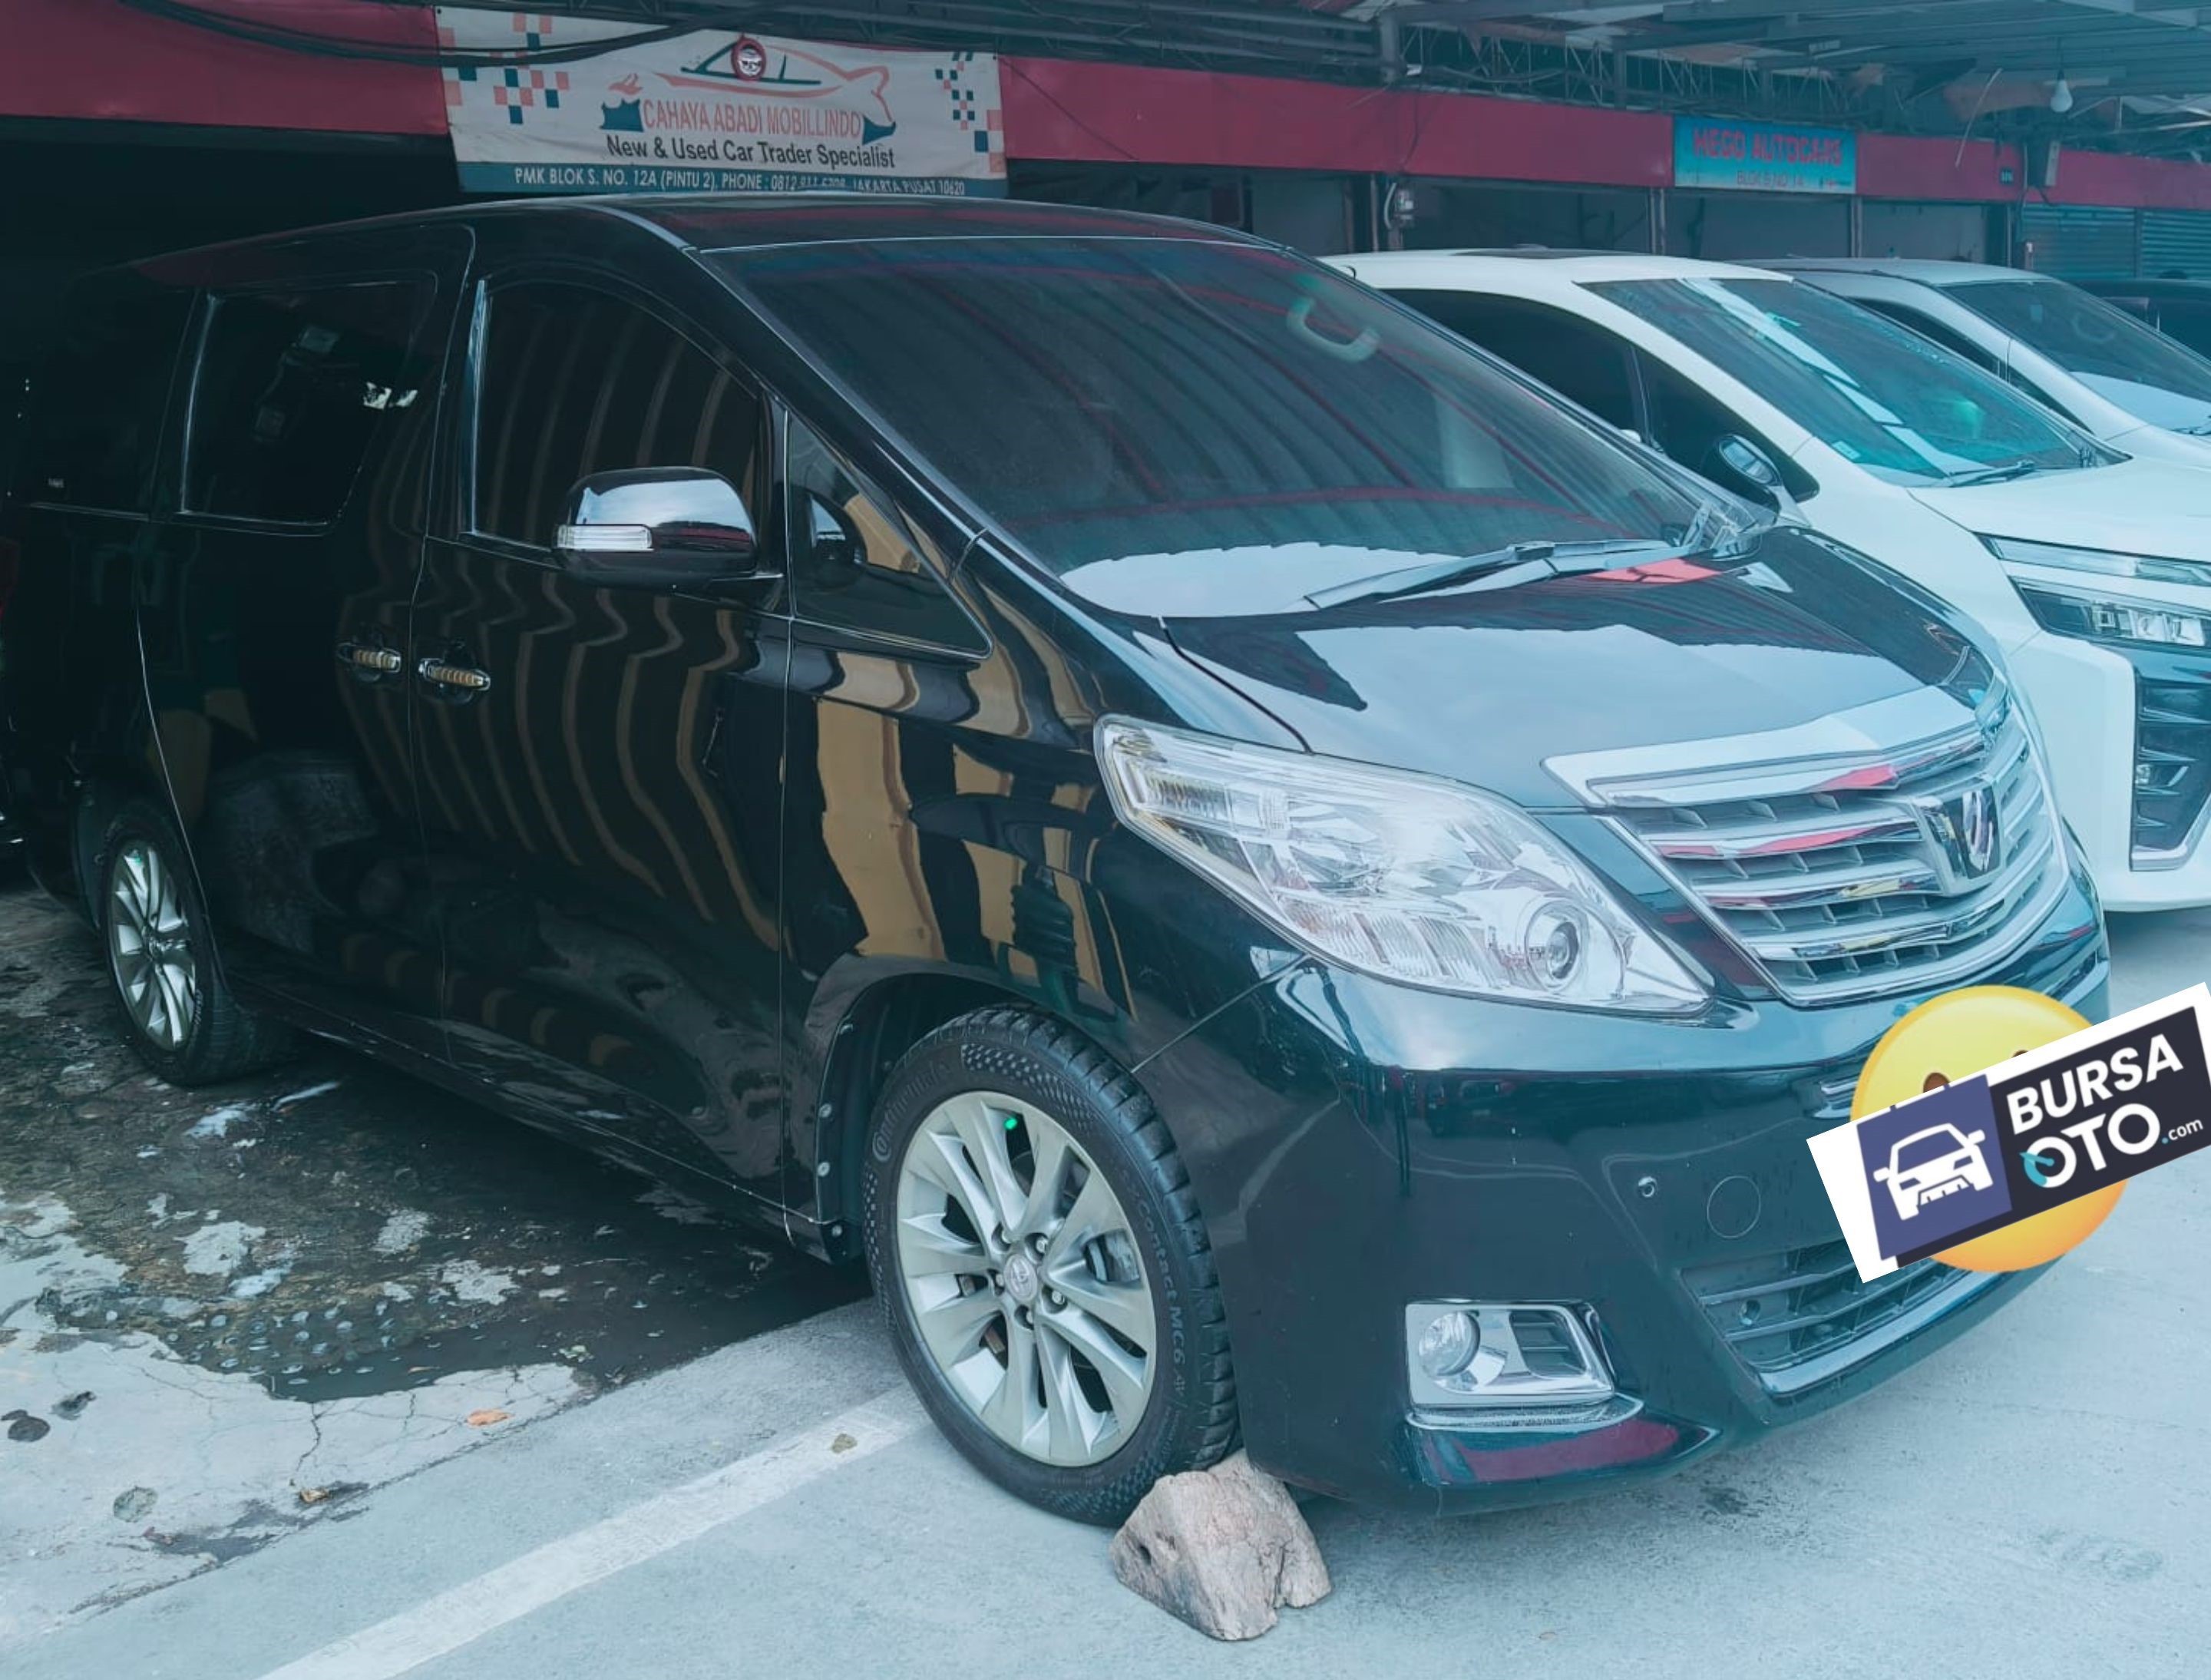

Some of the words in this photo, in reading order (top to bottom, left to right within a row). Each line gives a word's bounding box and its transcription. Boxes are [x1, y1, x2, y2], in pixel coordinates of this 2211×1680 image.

[643, 98, 712, 132] CAHAYA
[714, 103, 762, 134] ABADI
[767, 106, 861, 137] MOBILLINDO
[606, 134, 647, 158] New
[654, 136, 666, 158] &
[673, 137, 716, 160] Used
[722, 140, 752, 162] Car
[757, 141, 811, 164] Trader
[816, 144, 896, 168] Specialist
[514, 167, 544, 184] PMK
[550, 168, 584, 185] BLOK
[603, 170, 628, 186] NO.
[634, 170, 656, 186] 12A
[660, 170, 699, 190] (PINTU
